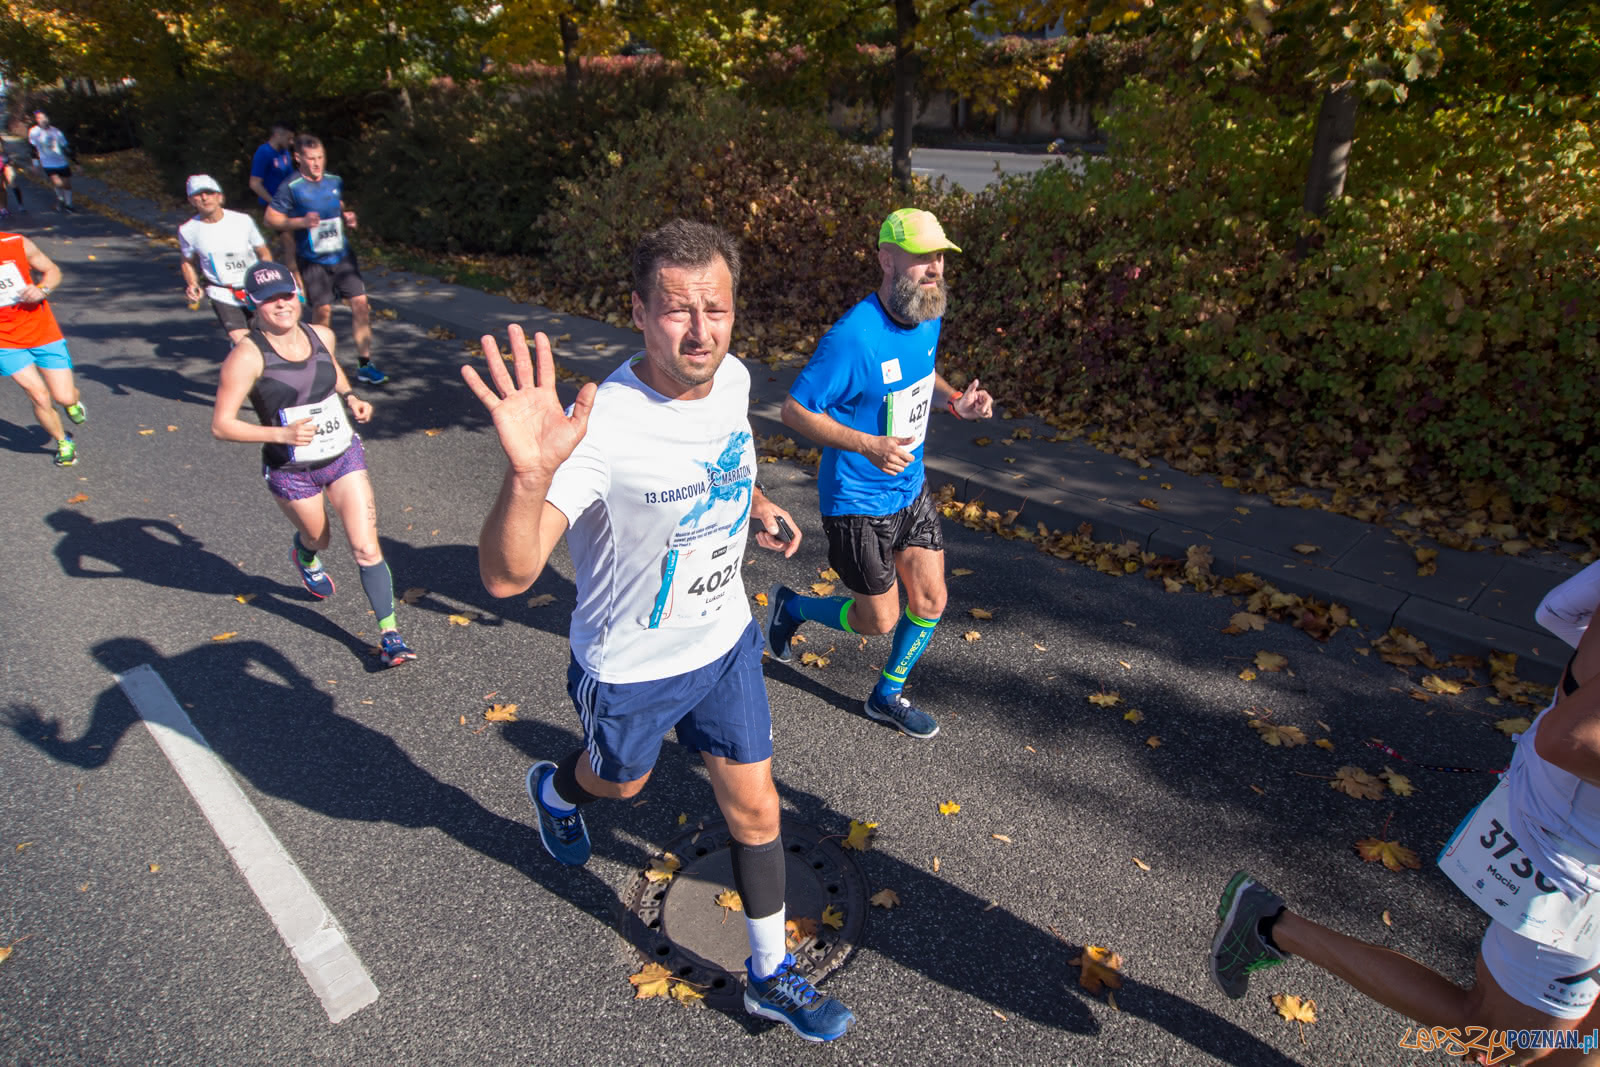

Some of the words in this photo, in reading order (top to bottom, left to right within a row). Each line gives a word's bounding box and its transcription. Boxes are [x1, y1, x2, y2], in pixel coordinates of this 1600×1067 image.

[909, 399, 928, 424] 427
[721, 464, 752, 485] MARATON
[1486, 863, 1521, 895] Maciej
